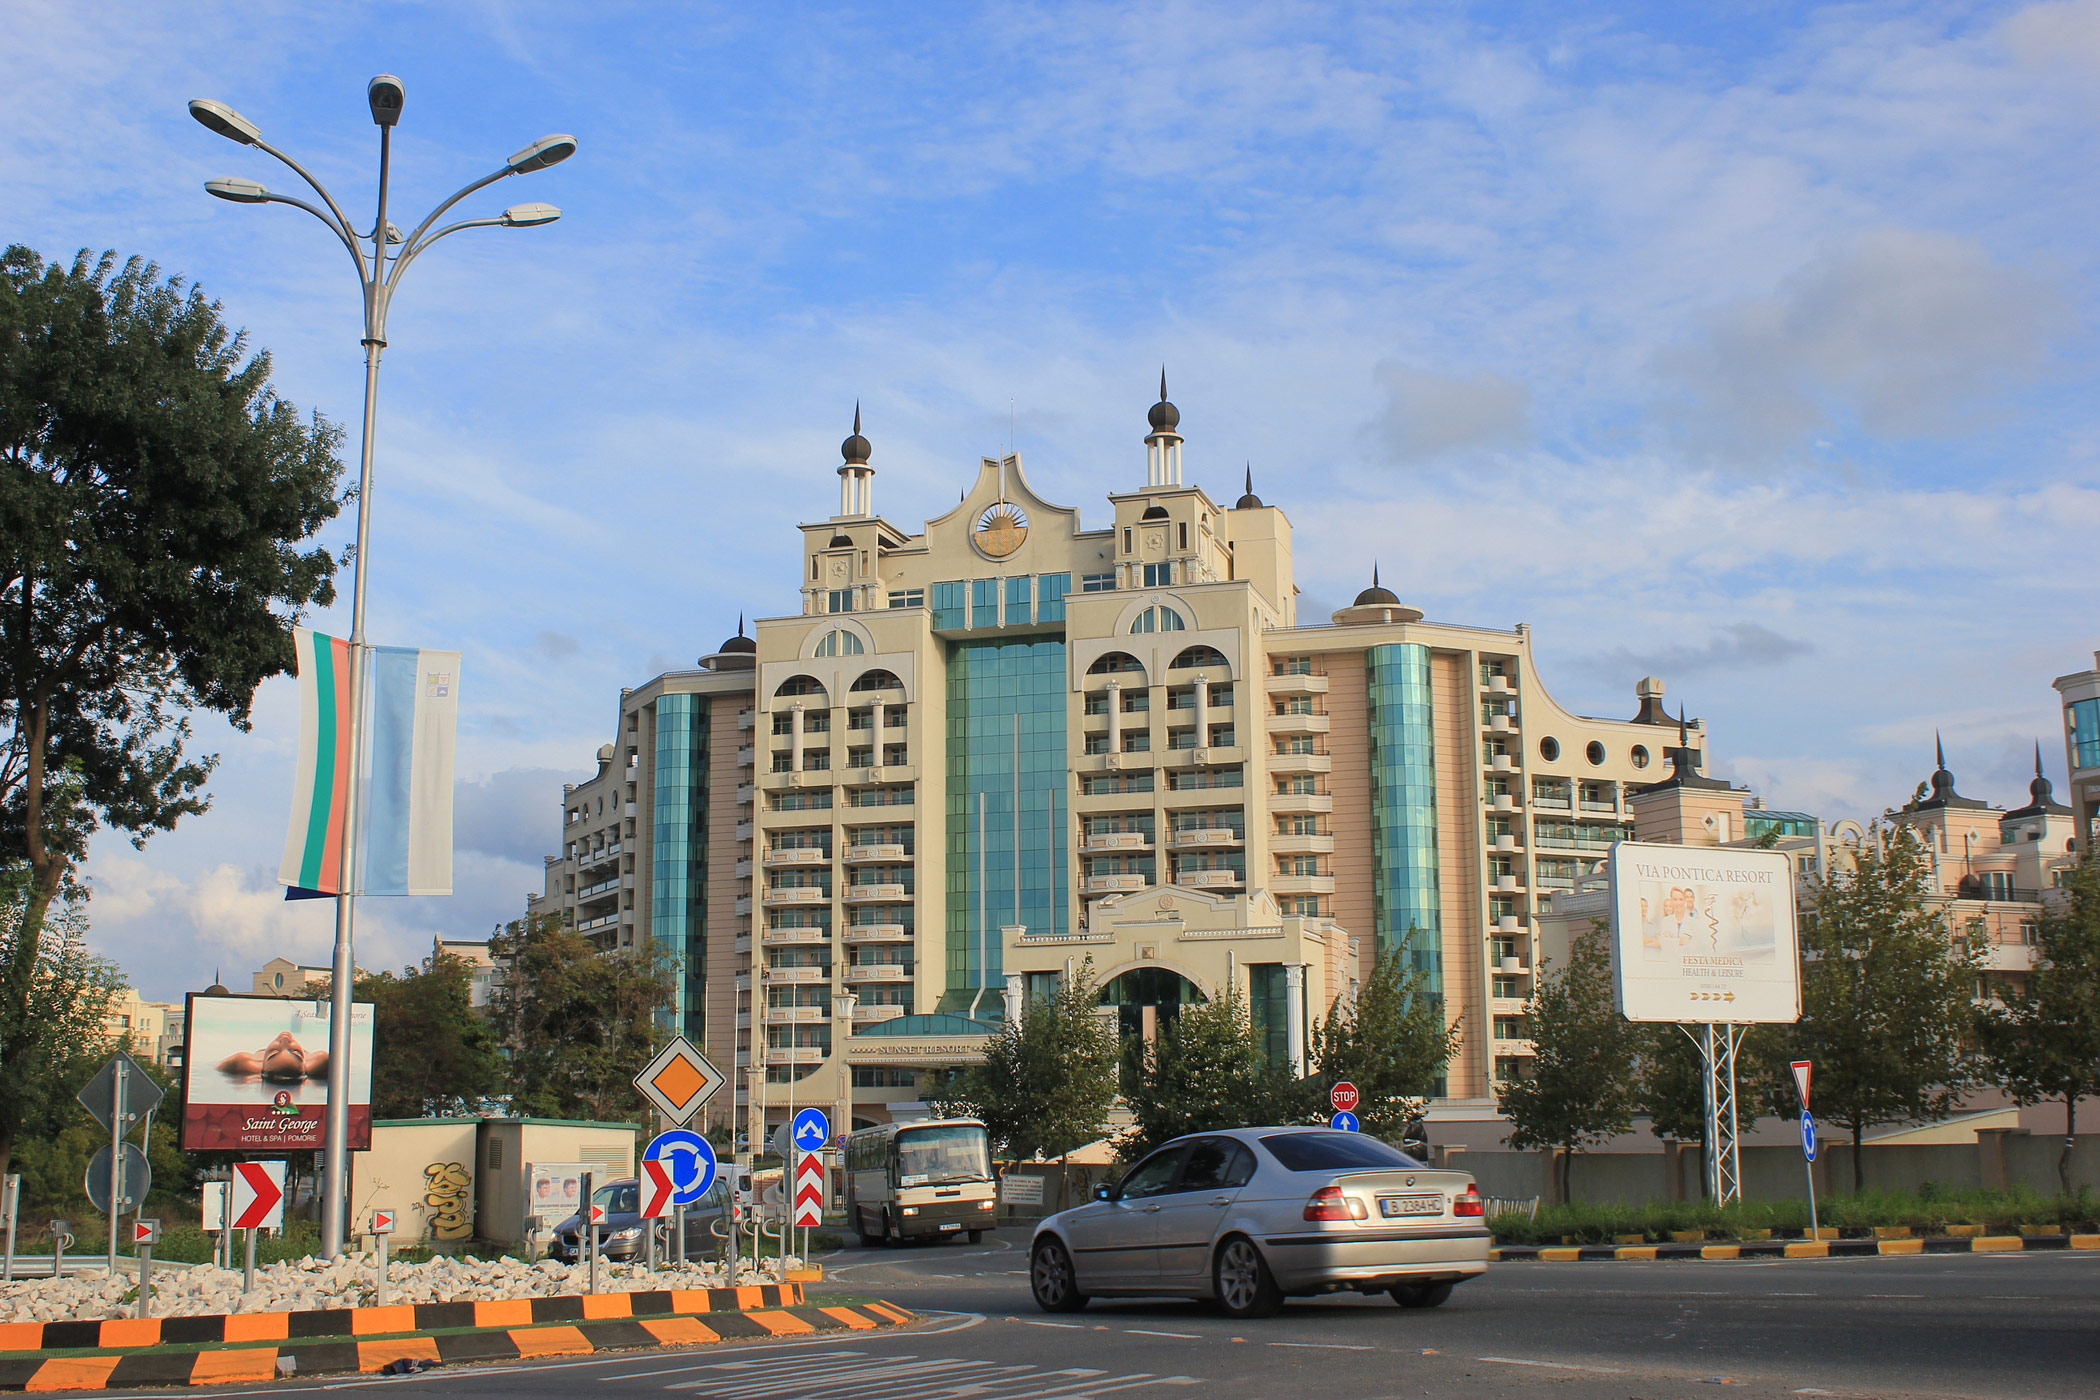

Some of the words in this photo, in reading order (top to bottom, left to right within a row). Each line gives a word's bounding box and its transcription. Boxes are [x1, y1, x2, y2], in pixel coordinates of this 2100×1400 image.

[1636, 864, 1660, 878] VIA
[1663, 866, 1724, 882] PONTICA
[1725, 870, 1774, 884] RESORT
[1682, 956, 1709, 965] FESTA
[1710, 956, 1743, 966] MEDICA
[1682, 967, 1710, 977] HEALTH
[1718, 968, 1744, 978] LEISURE
[879, 1046, 922, 1054] SUNSET
[926, 1045, 970, 1054] RESORT
[1333, 1091, 1356, 1102] STOP
[242, 1116, 277, 1131] Saint
[278, 1117, 318, 1134] George
